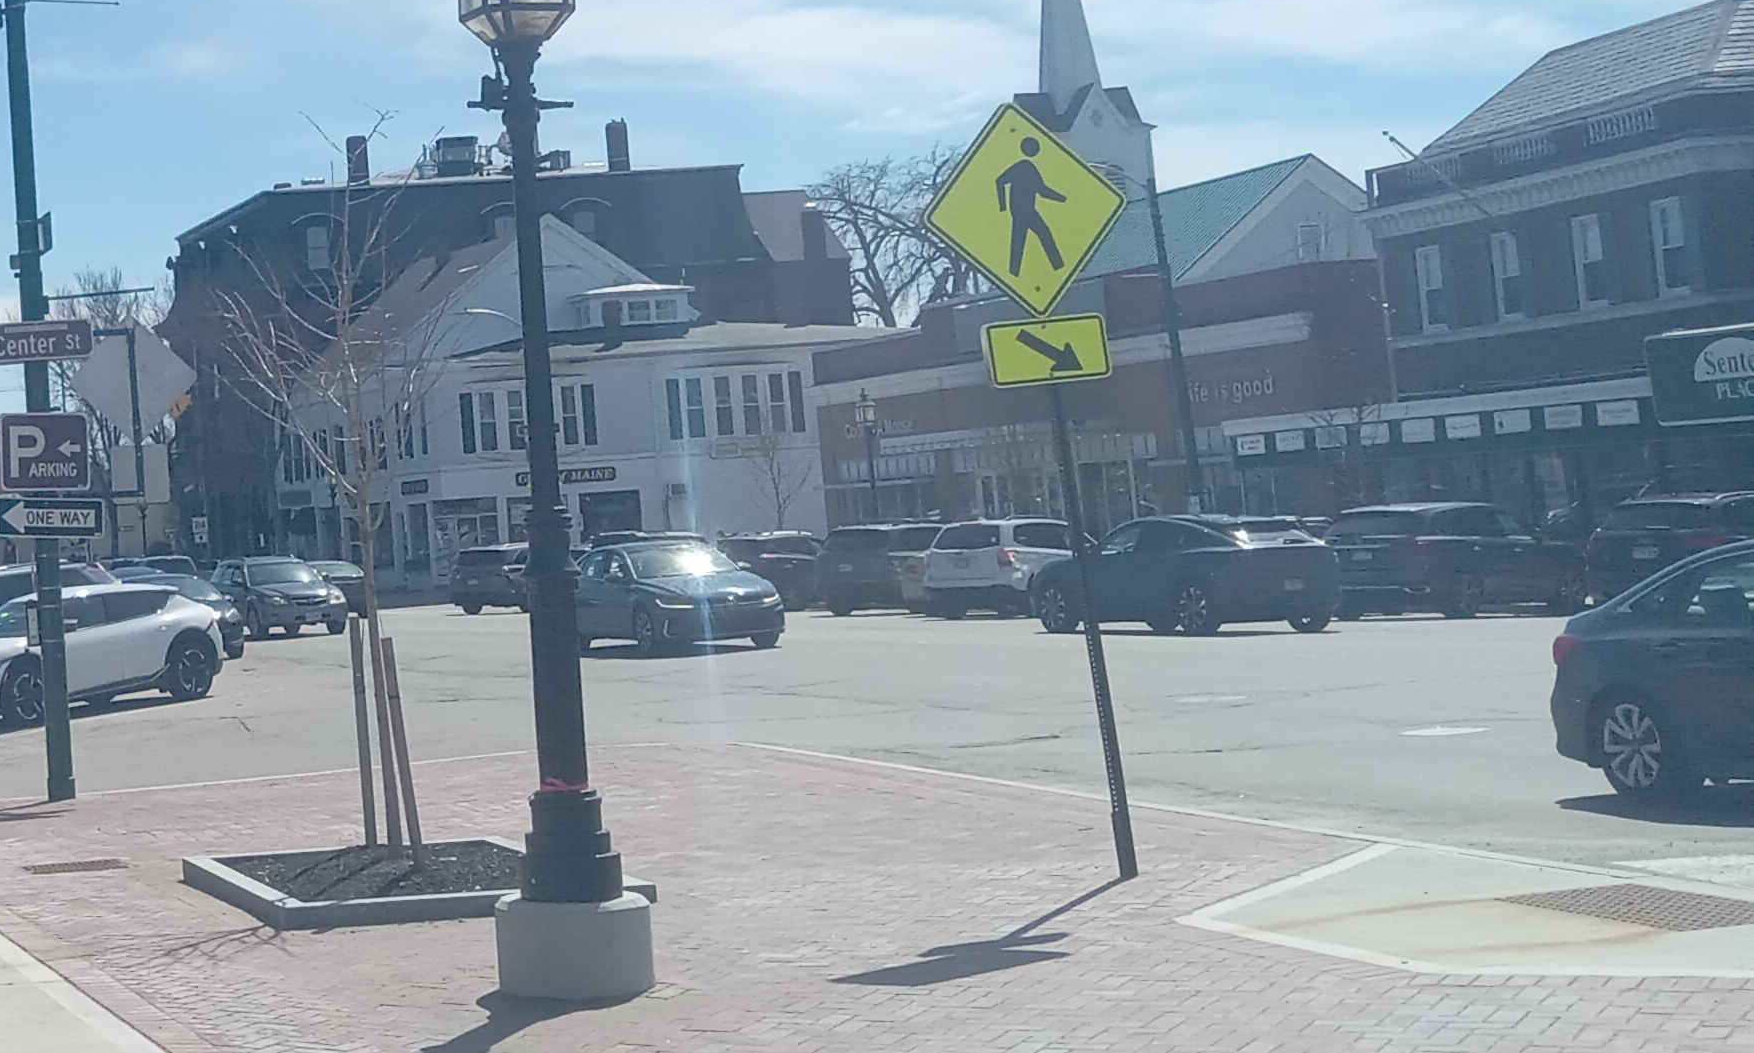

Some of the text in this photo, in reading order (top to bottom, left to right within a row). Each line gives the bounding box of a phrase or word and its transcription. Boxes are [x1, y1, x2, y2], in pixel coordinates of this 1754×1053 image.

[66, 333, 80, 349] St
[1189, 381, 1208, 402] ife
[1232, 374, 1273, 403] good
[571, 469, 613, 480] MAINE
[26, 510, 91, 525] ONE WAY
